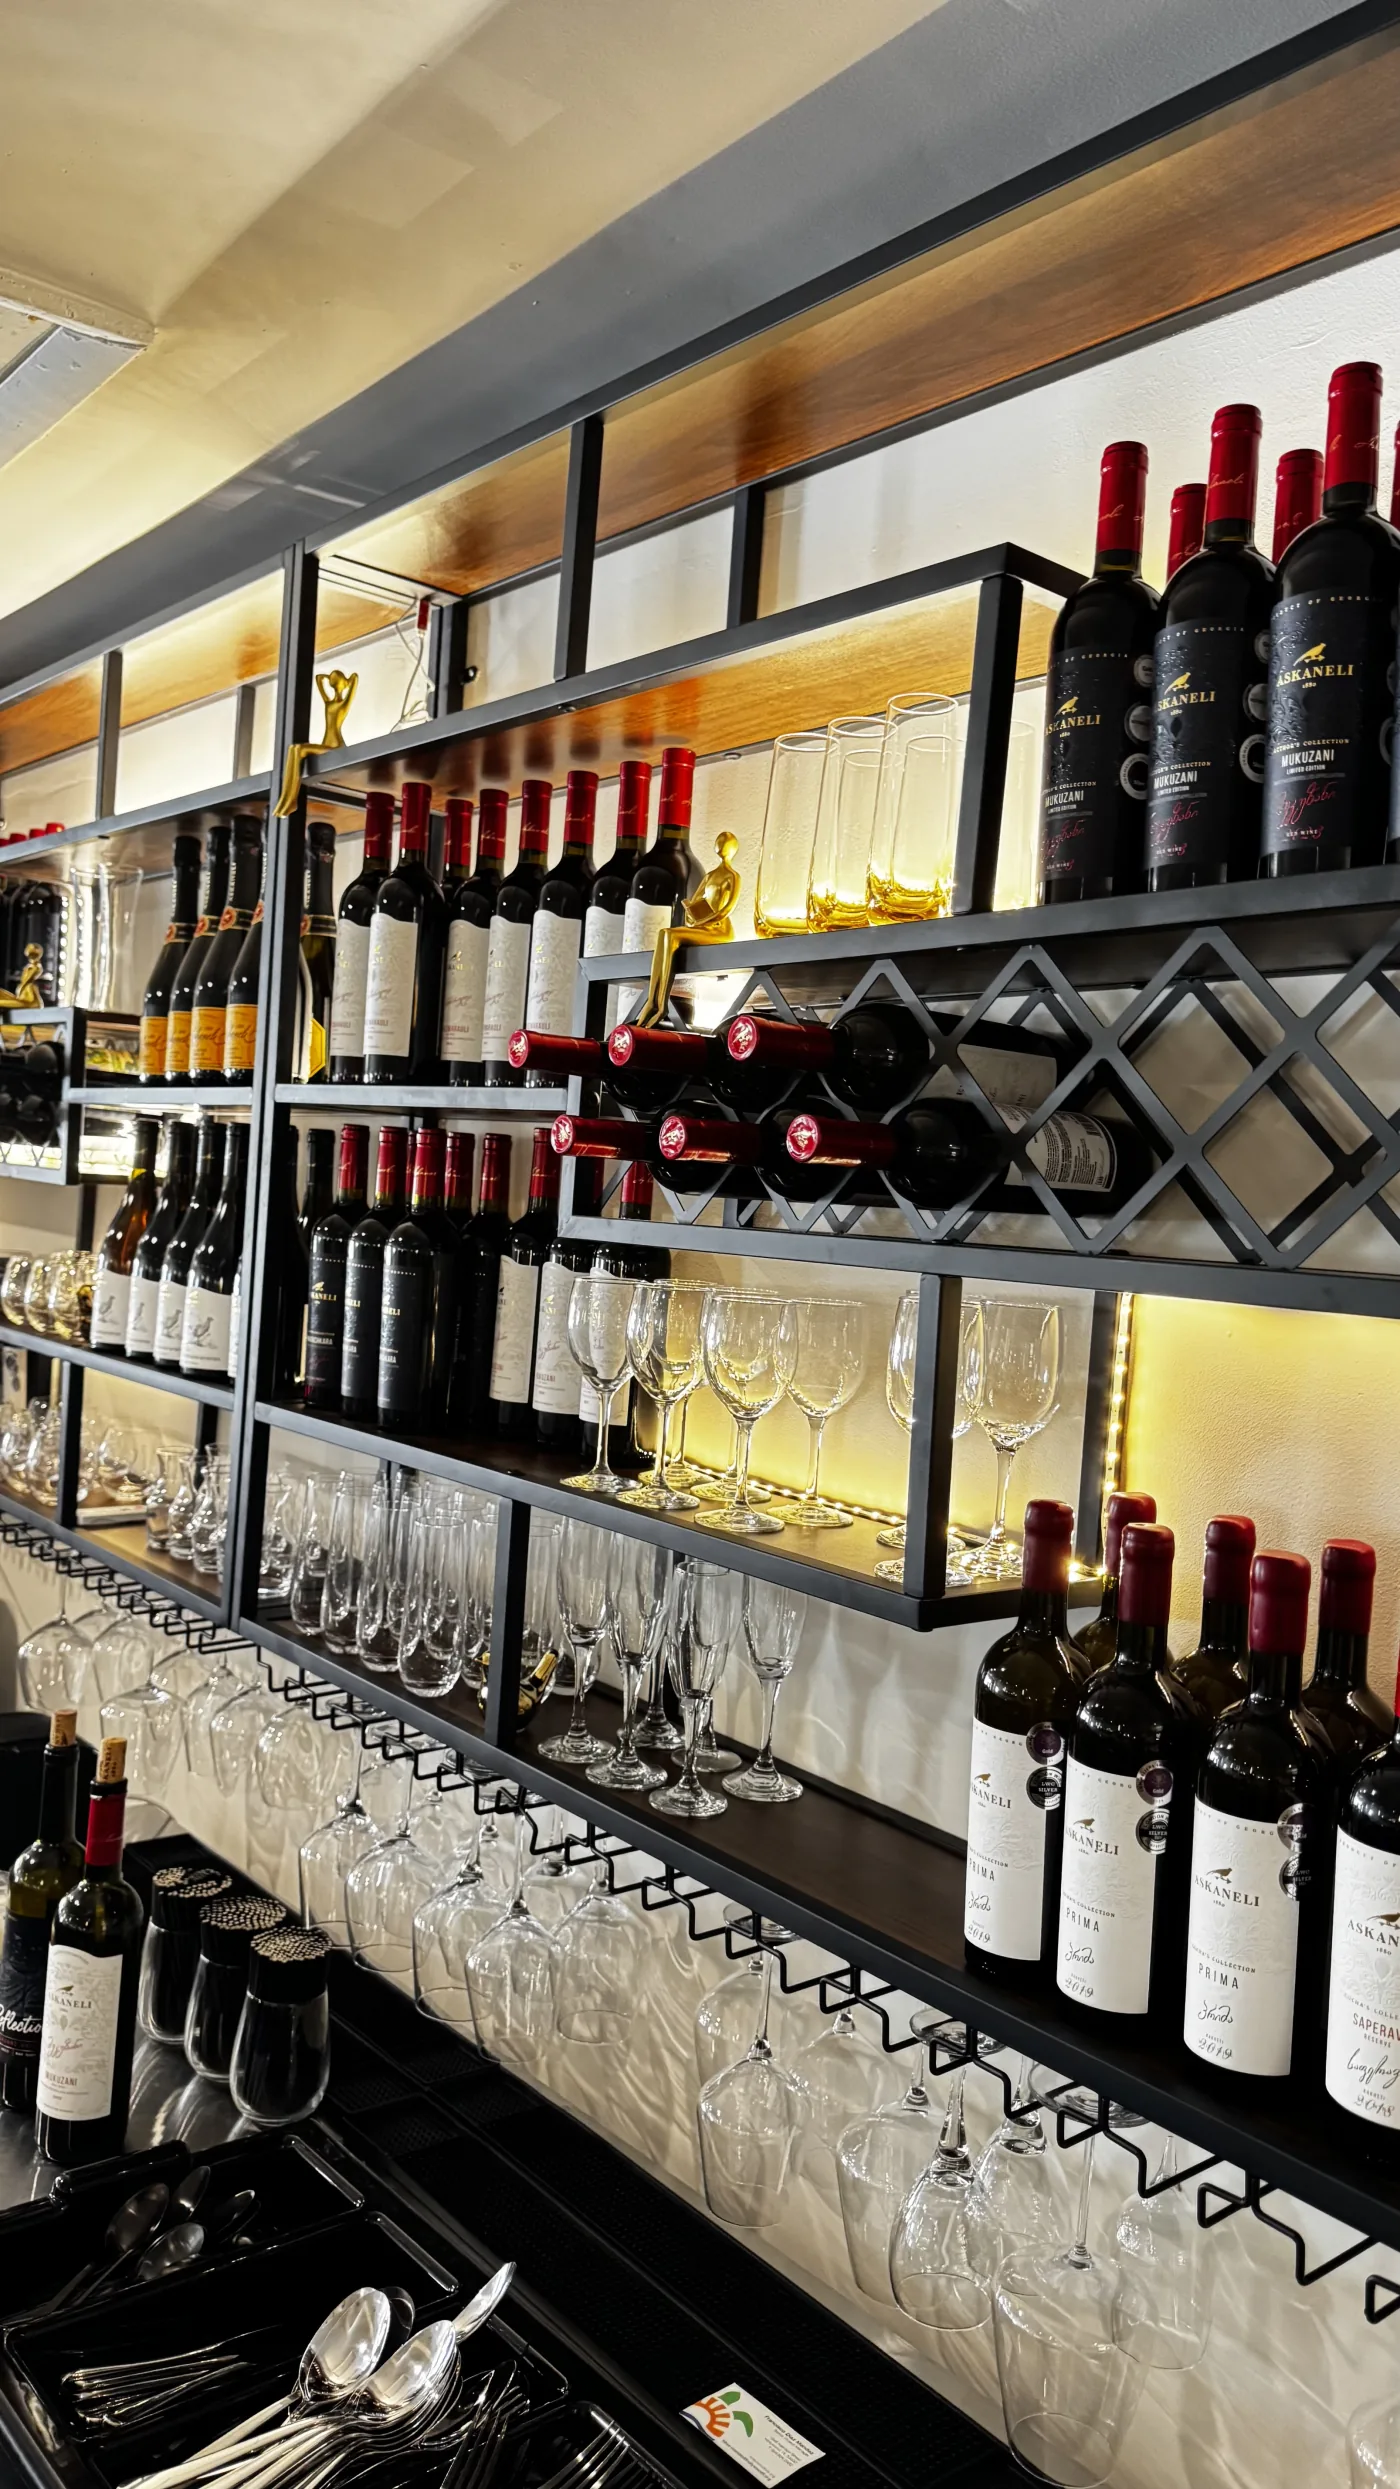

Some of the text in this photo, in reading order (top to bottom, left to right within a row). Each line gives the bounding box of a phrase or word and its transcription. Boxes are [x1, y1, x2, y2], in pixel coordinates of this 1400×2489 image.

[1081, 652, 1128, 660] GEORGIA
[1275, 664, 1354, 687] ASKANELI
[1156, 690, 1216, 711] SKANELI
[1302, 738, 1350, 747] COLLECTION
[1170, 761, 1211, 770] COLLECTION
[1281, 748, 1335, 768] MUKUZANI
[1286, 764, 1326, 775] LIMITED EDITION
[1059, 781, 1097, 790] COLLECTION
[1153, 771, 1198, 789] MUKUZANI
[1045, 790, 1084, 808] MUKUZANI
[1236, 1824, 1274, 1836] GEORG
[969, 1857, 995, 1882] PRIMA
[1384, 1860, 1397, 1868] OF
[1195, 1875, 1260, 1907] ASKANELI
[1077, 1901, 1115, 1918] COLLECTION
[1066, 1907, 1099, 1933] PRIMA
[1376, 1947, 1392, 1956] 1880
[1212, 1956, 1256, 1974] COLLECTION
[1198, 1962, 1239, 1990] PRIMA
[1065, 1977, 1094, 1998] 2019
[1198, 2037, 1233, 2060] 2019
[1364, 2033, 1392, 2049] RESERVE
